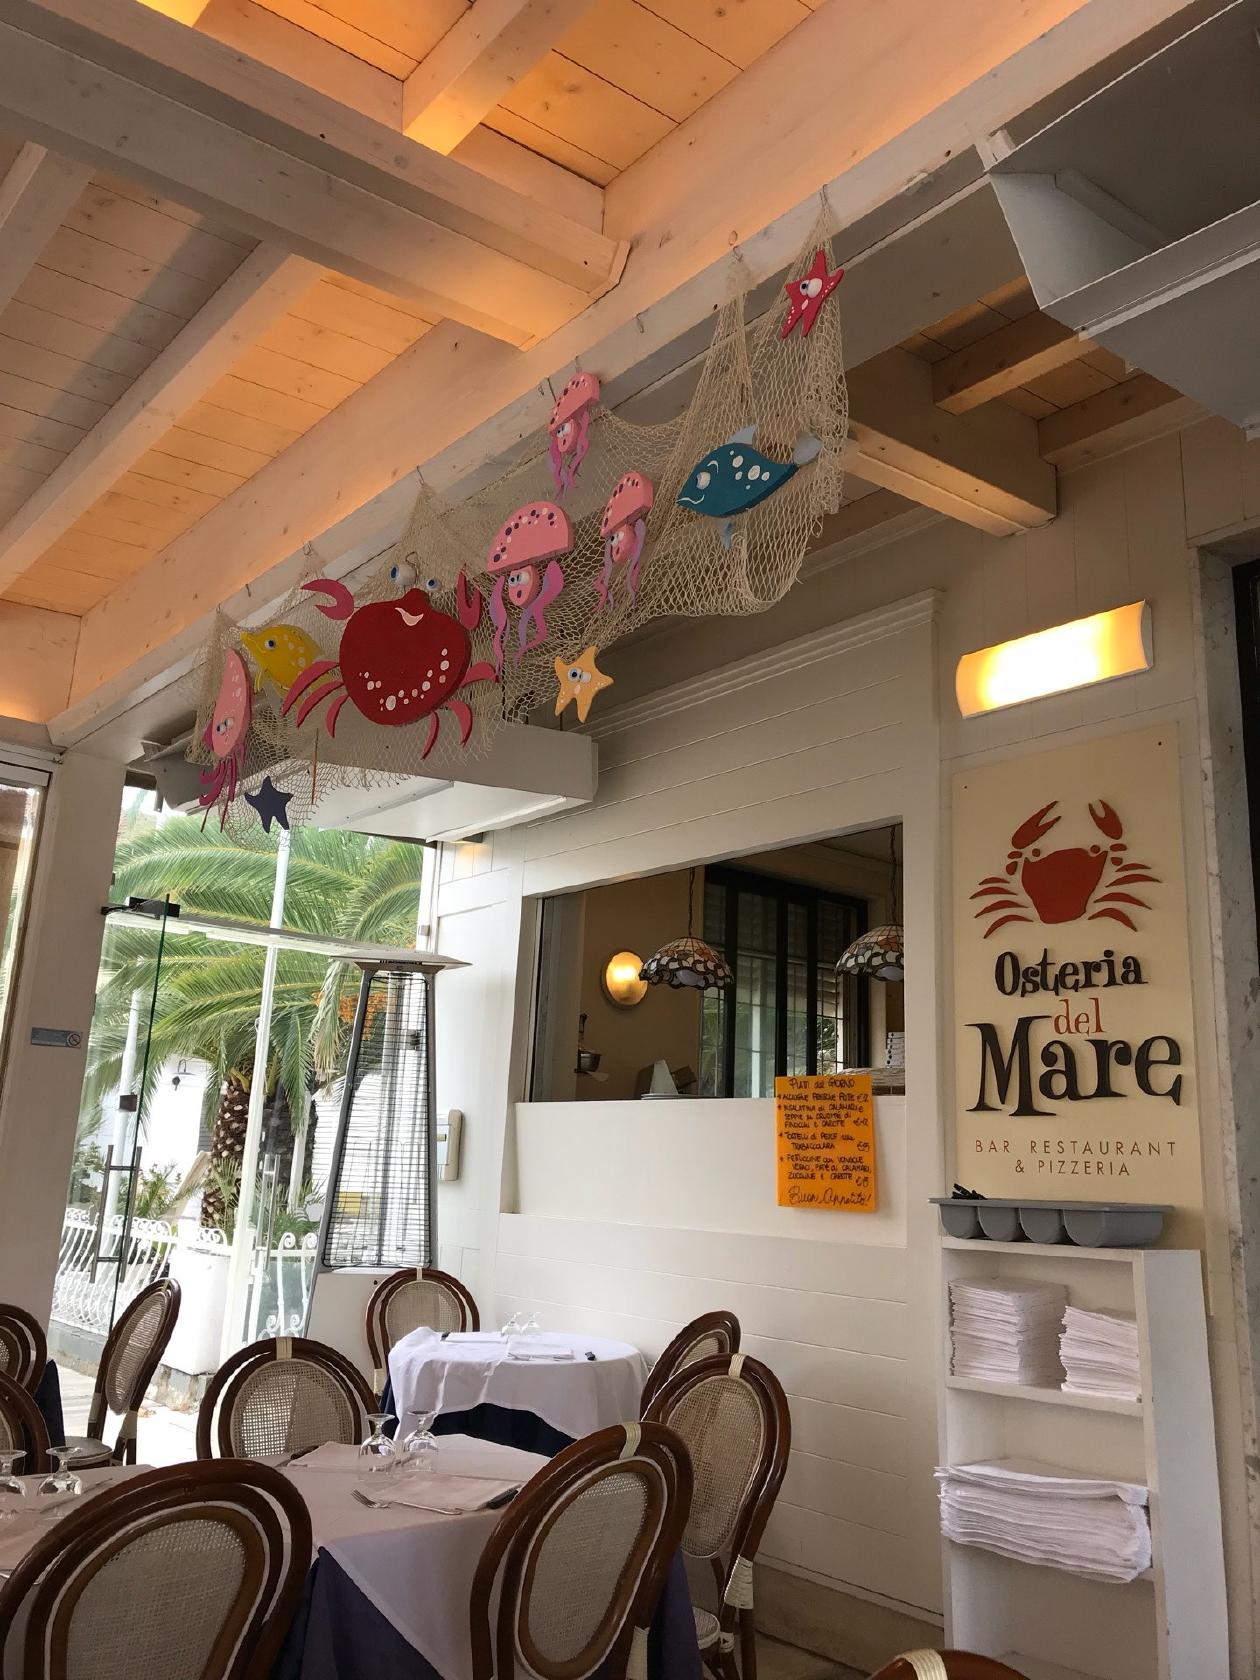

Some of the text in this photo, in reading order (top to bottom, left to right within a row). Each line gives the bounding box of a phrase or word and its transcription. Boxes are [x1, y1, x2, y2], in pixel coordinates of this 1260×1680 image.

[994, 948, 1149, 997] Osteria
[1053, 997, 1107, 1037] del
[964, 1014, 1183, 1117] Mare
[975, 1139, 1176, 1156] BAR RESTAURANT
[1015, 1159, 1130, 1176] & PIZZERIA
